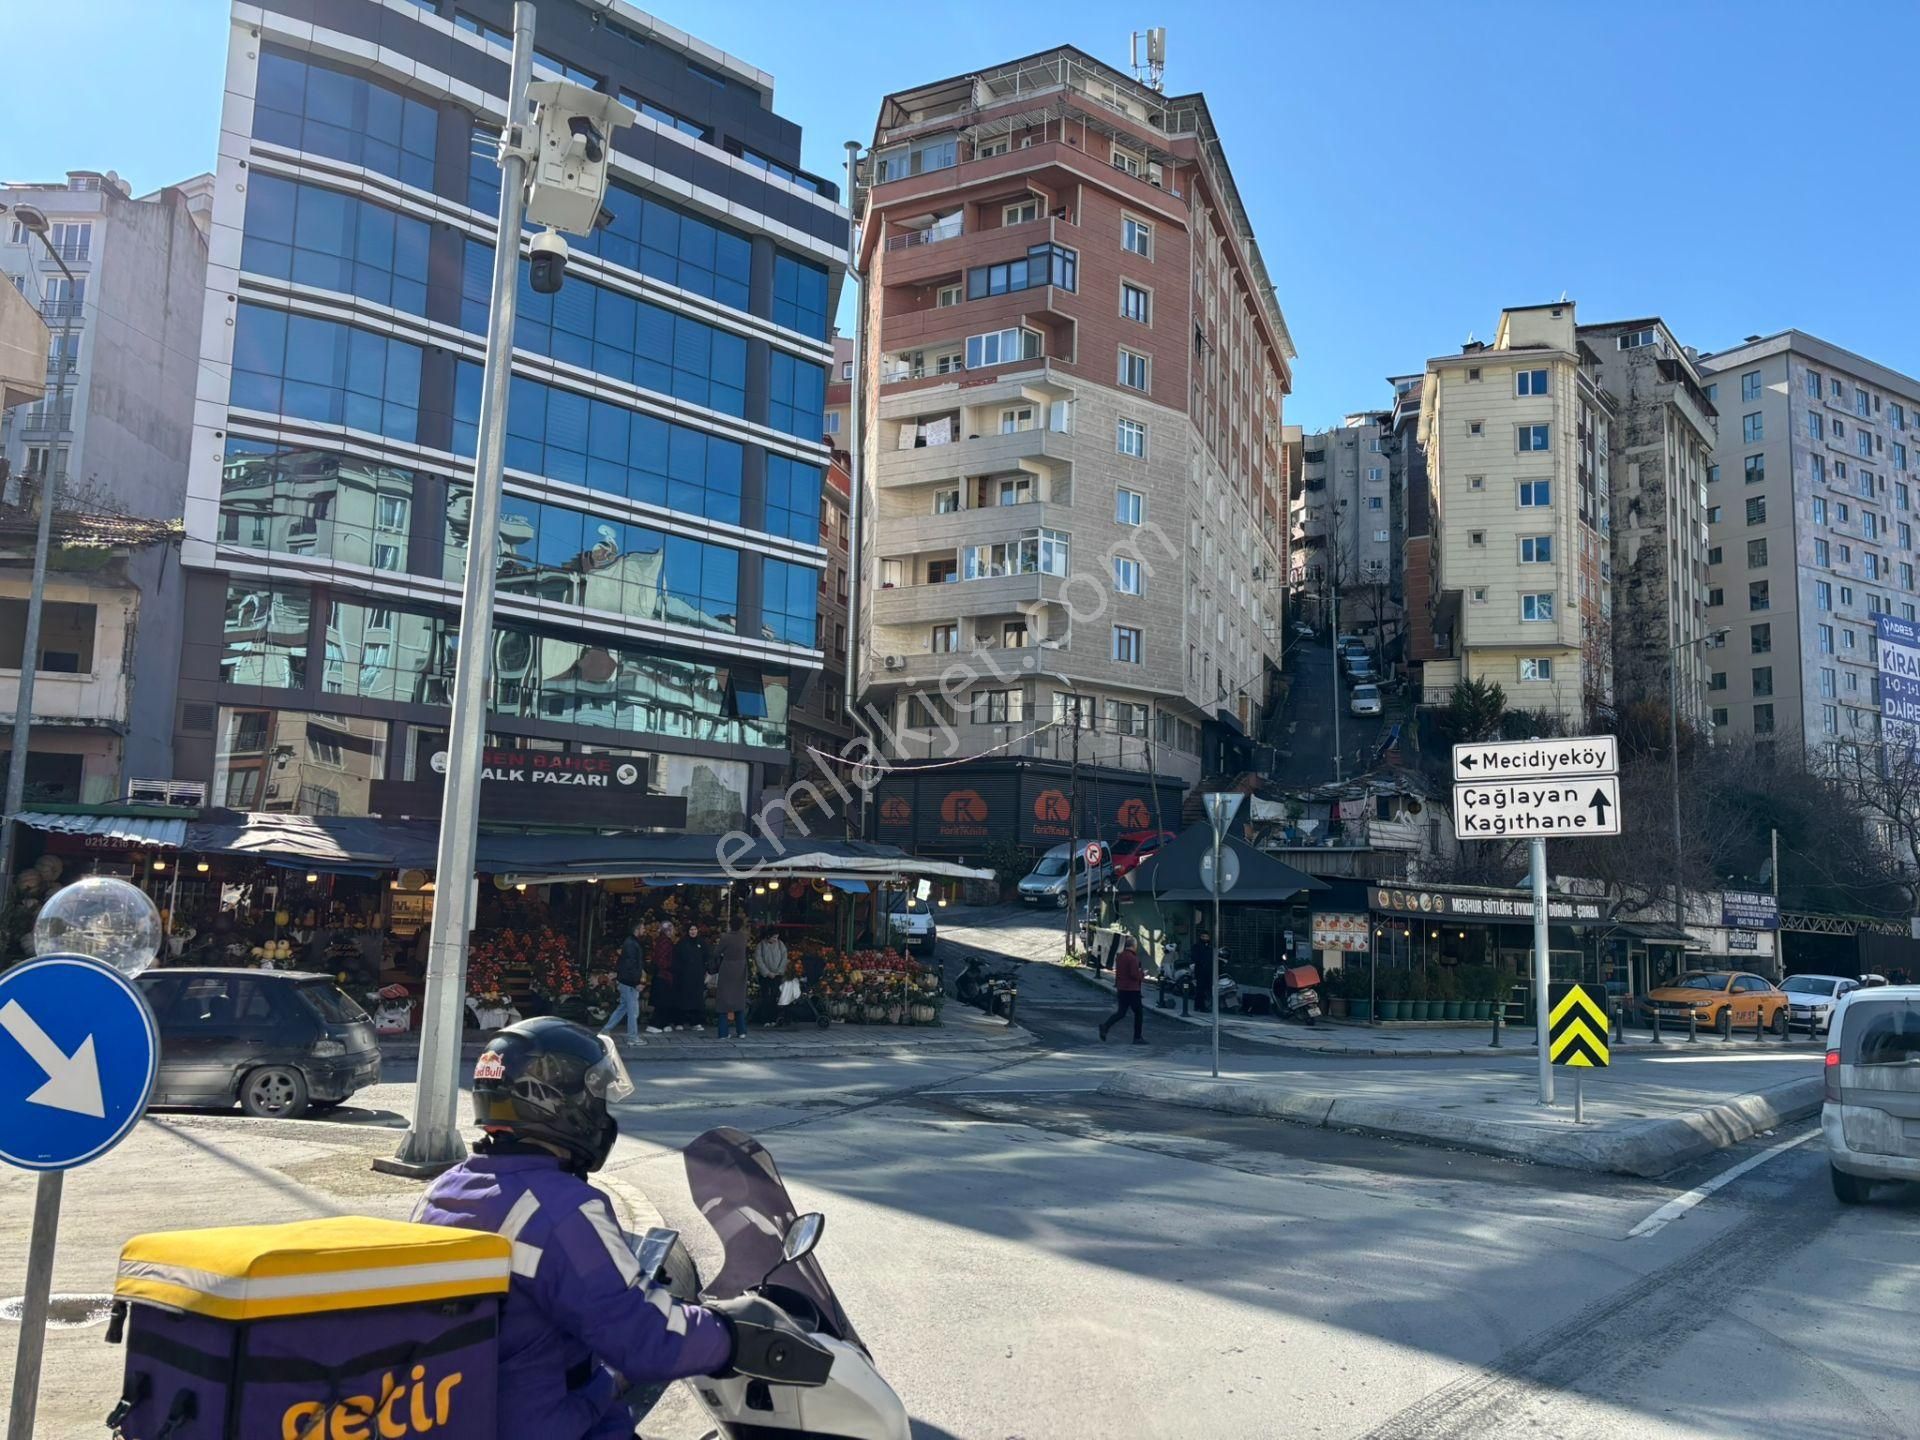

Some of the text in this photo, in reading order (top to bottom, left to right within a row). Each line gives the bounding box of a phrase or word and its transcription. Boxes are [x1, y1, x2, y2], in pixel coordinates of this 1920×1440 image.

[1483, 748, 1606, 771] Mecidiyeköy
[481, 768, 608, 787] ALK PAZARI
[1463, 787, 1578, 809] Çağlayan
[1465, 812, 1587, 834] Kağıthane
[85, 837, 109, 848] 0212
[1452, 897, 1482, 914] MEŞHUR
[1483, 898, 1514, 915] SÜTLÜCE
[1549, 902, 1573, 918] DÜRÜM
[1577, 904, 1600, 919] ÇORBA
[485, 1066, 502, 1077] Bull
